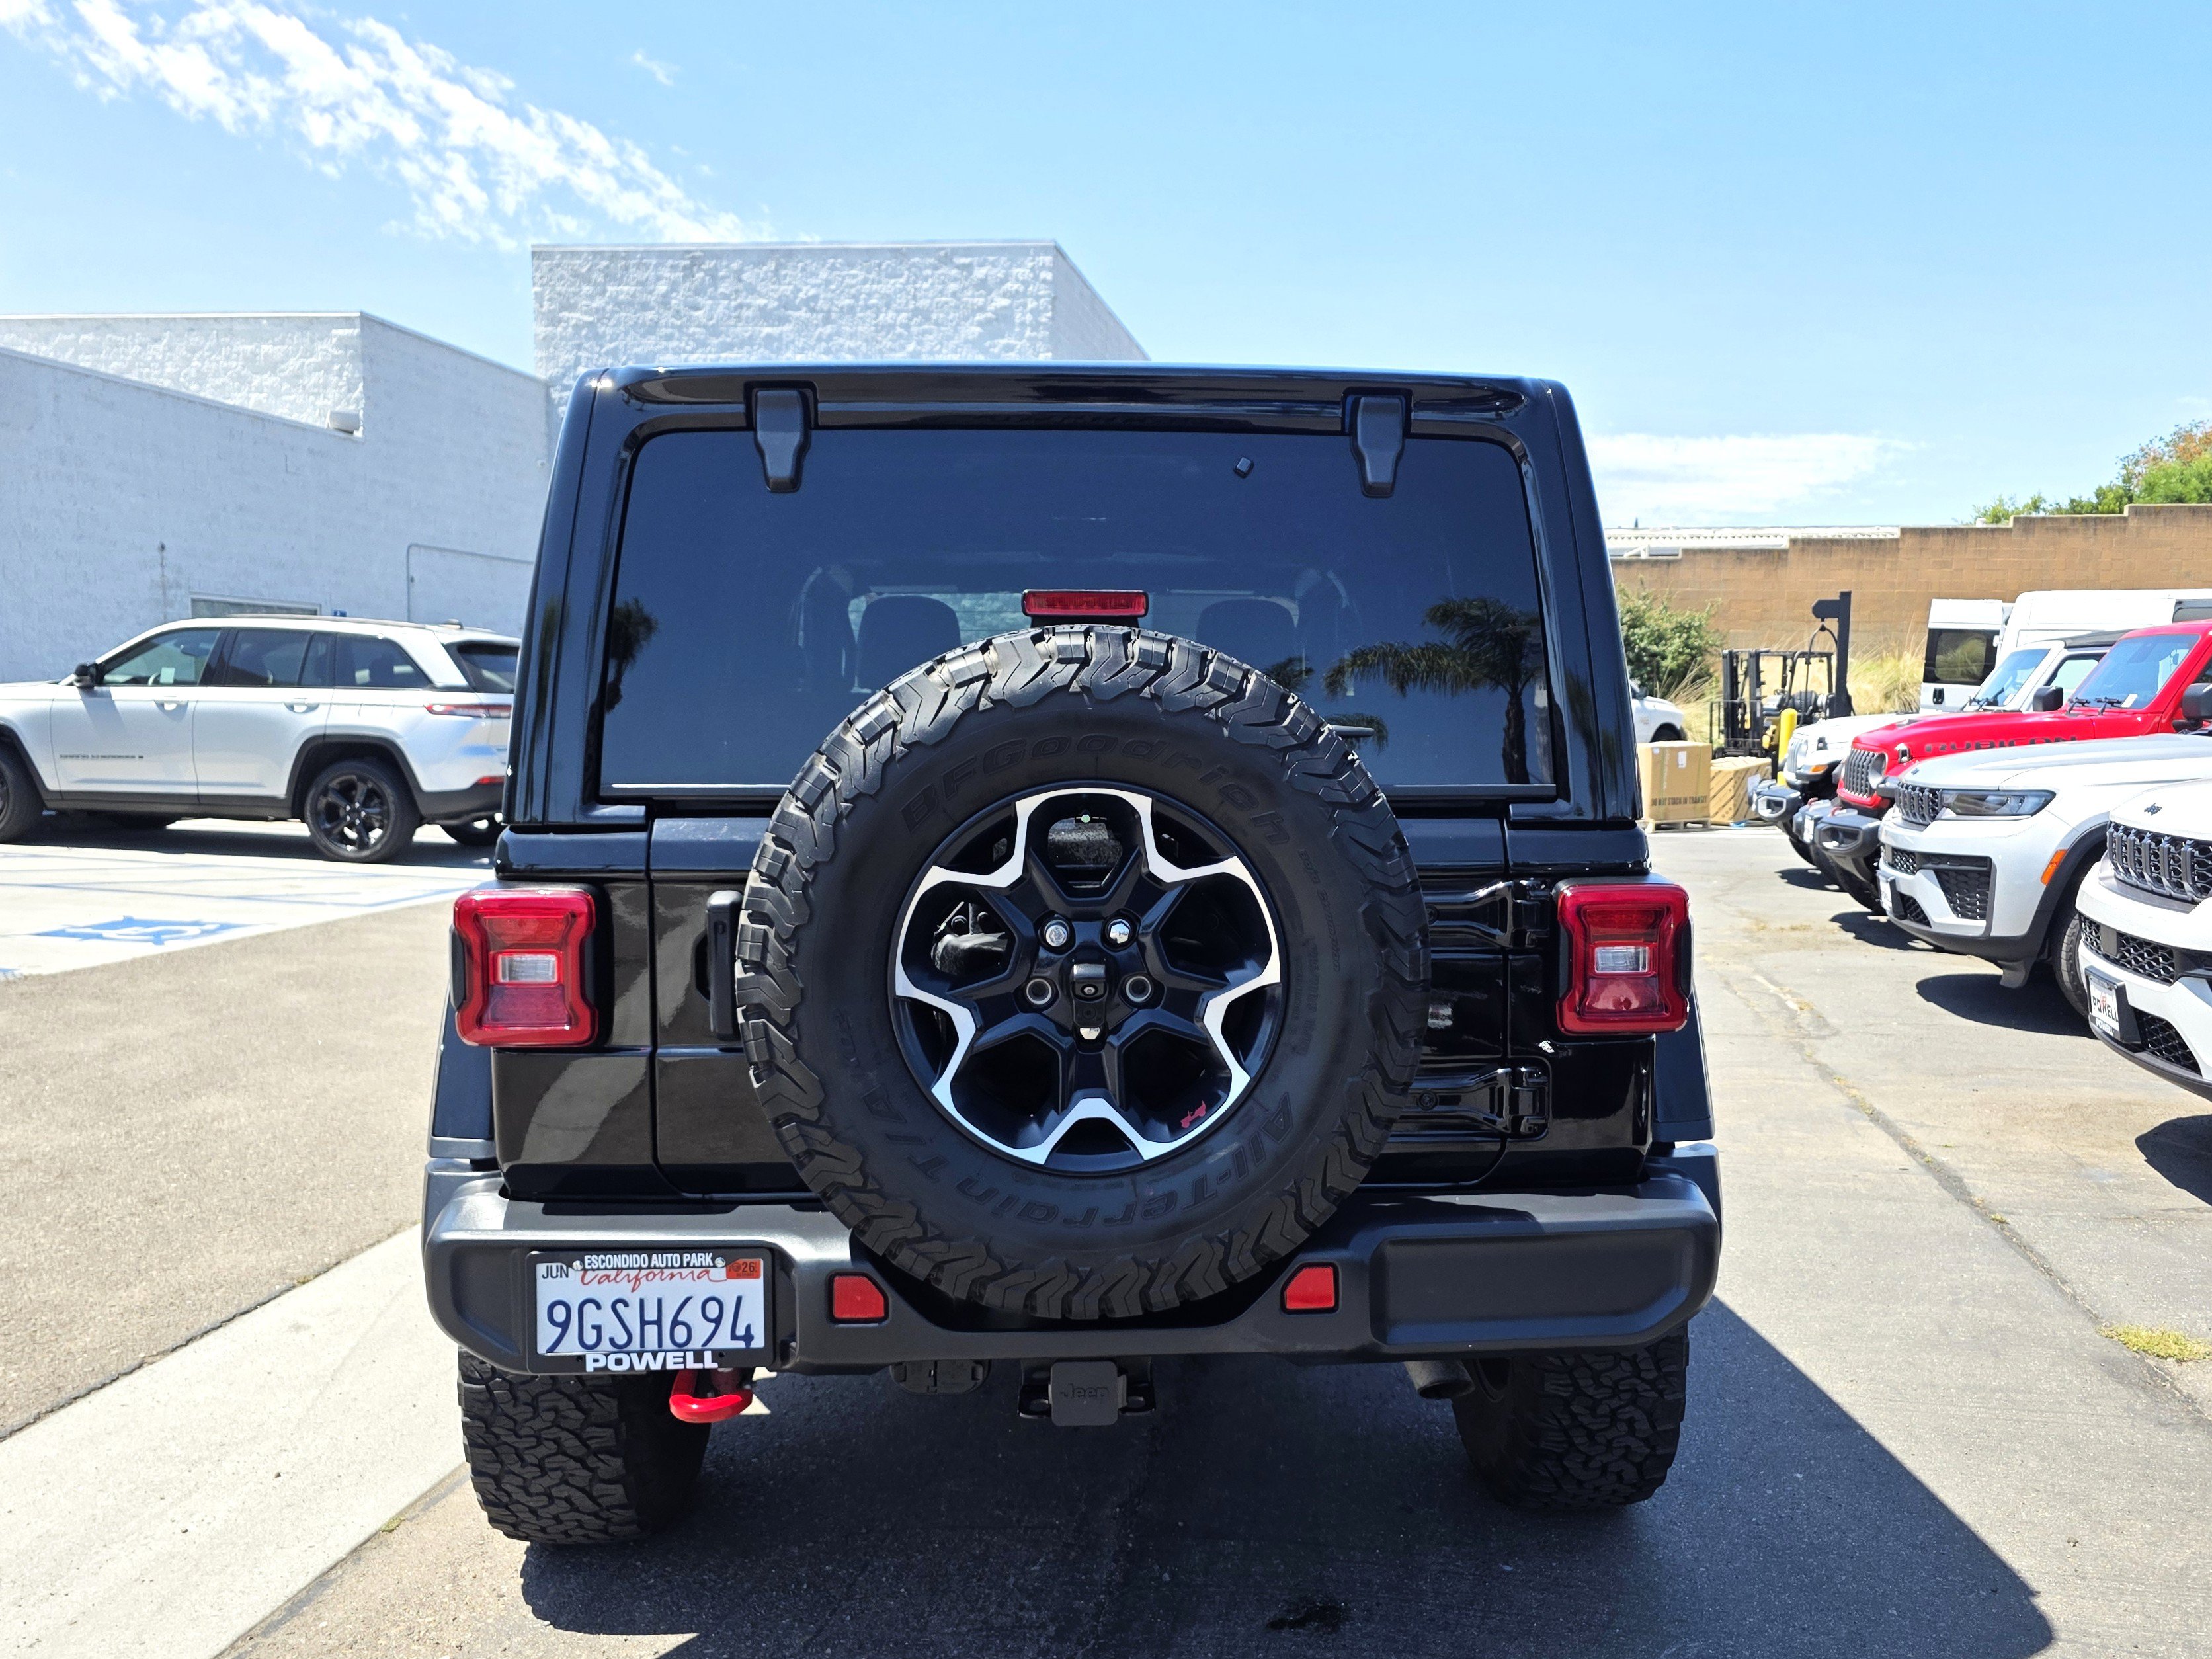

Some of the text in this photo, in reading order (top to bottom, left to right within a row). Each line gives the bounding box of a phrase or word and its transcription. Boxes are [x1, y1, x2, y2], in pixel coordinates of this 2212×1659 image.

[899, 732, 1290, 845] BFGoodrich
[2092, 996, 2119, 1024] POWELL
[954, 1091, 1294, 1230] All-Terrain
[542, 1265, 569, 1279] JUN
[585, 1252, 714, 1270] ESCONDIDO AUTO PARK
[741, 1261, 755, 1273] 26
[580, 1268, 727, 1293] California
[546, 1295, 755, 1353] 9GSH694
[585, 1350, 718, 1373] POWELL
[1060, 1383, 1109, 1398] Jeep
